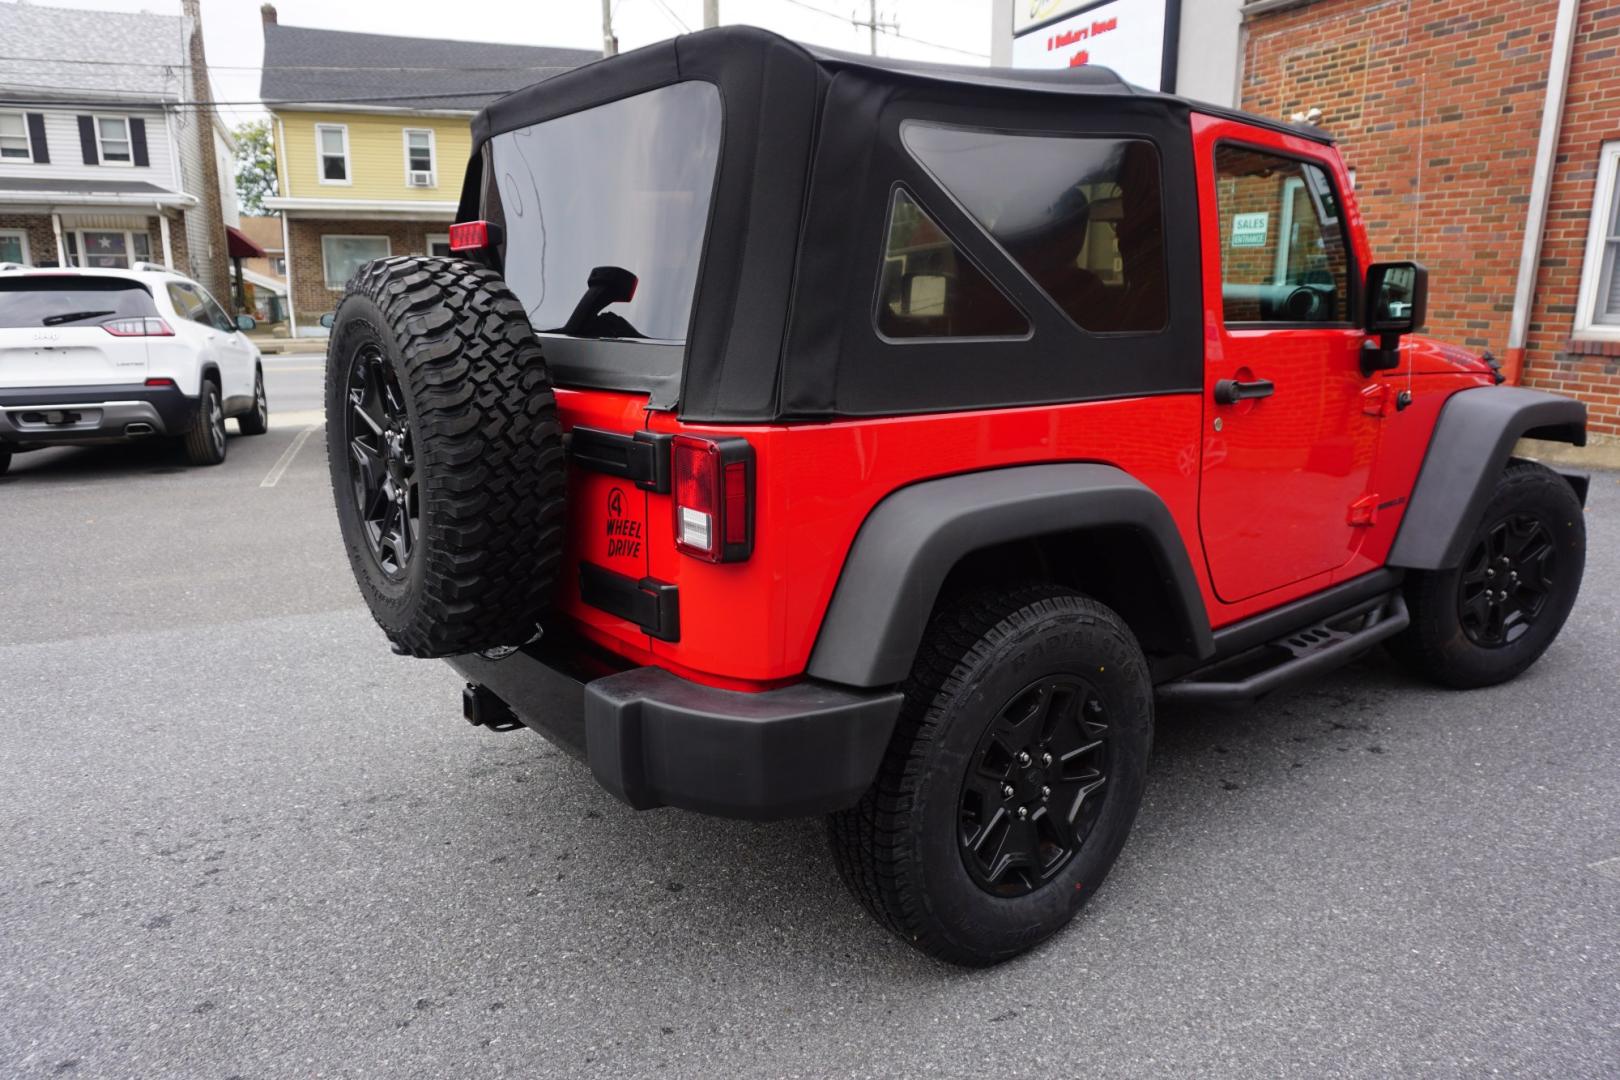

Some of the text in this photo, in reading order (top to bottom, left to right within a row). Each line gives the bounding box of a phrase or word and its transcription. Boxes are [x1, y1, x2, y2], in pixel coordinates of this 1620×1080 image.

[1236, 218, 1265, 230] SALES
[606, 519, 642, 539] WHEEL
[607, 538, 641, 558] DRIVE
